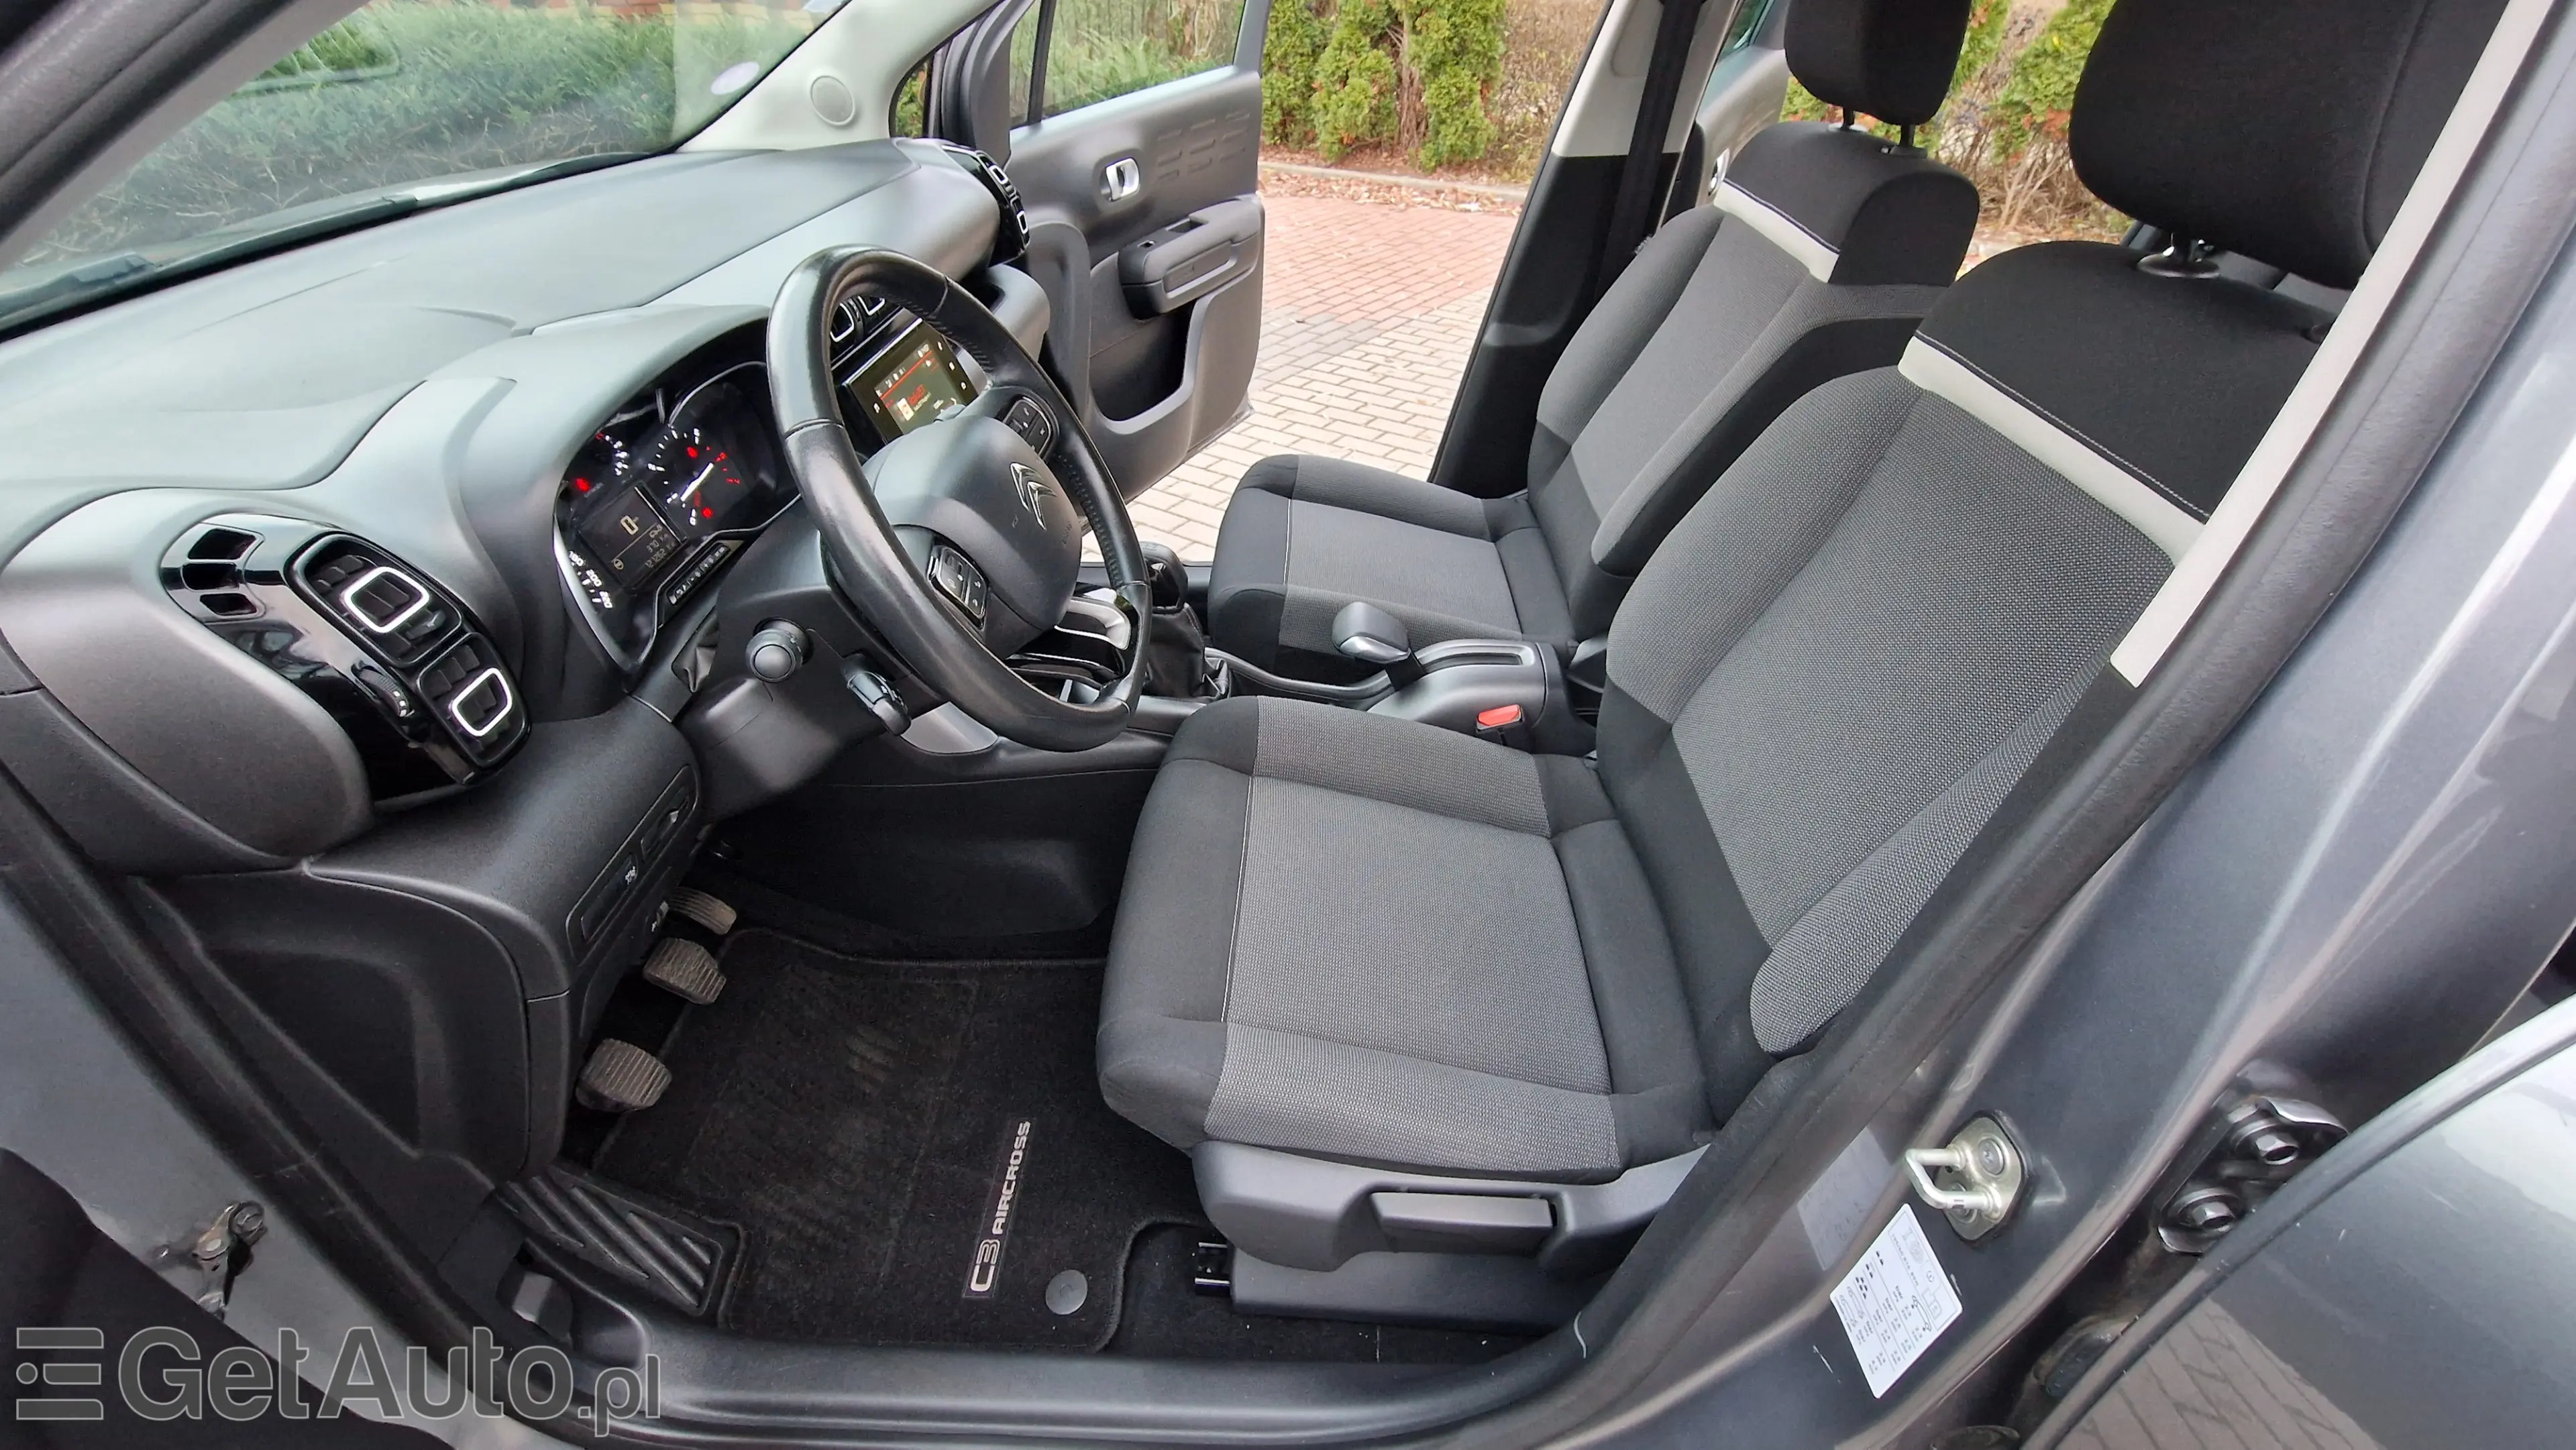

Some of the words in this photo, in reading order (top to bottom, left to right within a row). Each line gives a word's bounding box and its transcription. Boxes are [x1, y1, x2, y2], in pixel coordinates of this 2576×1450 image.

[621, 515, 639, 535] 0
[568, 551, 584, 567] 180
[586, 569, 602, 587] 200
[599, 591, 613, 608] 220
[970, 1239, 1000, 1292] C3
[991, 1121, 1031, 1235] AIRCROSS
